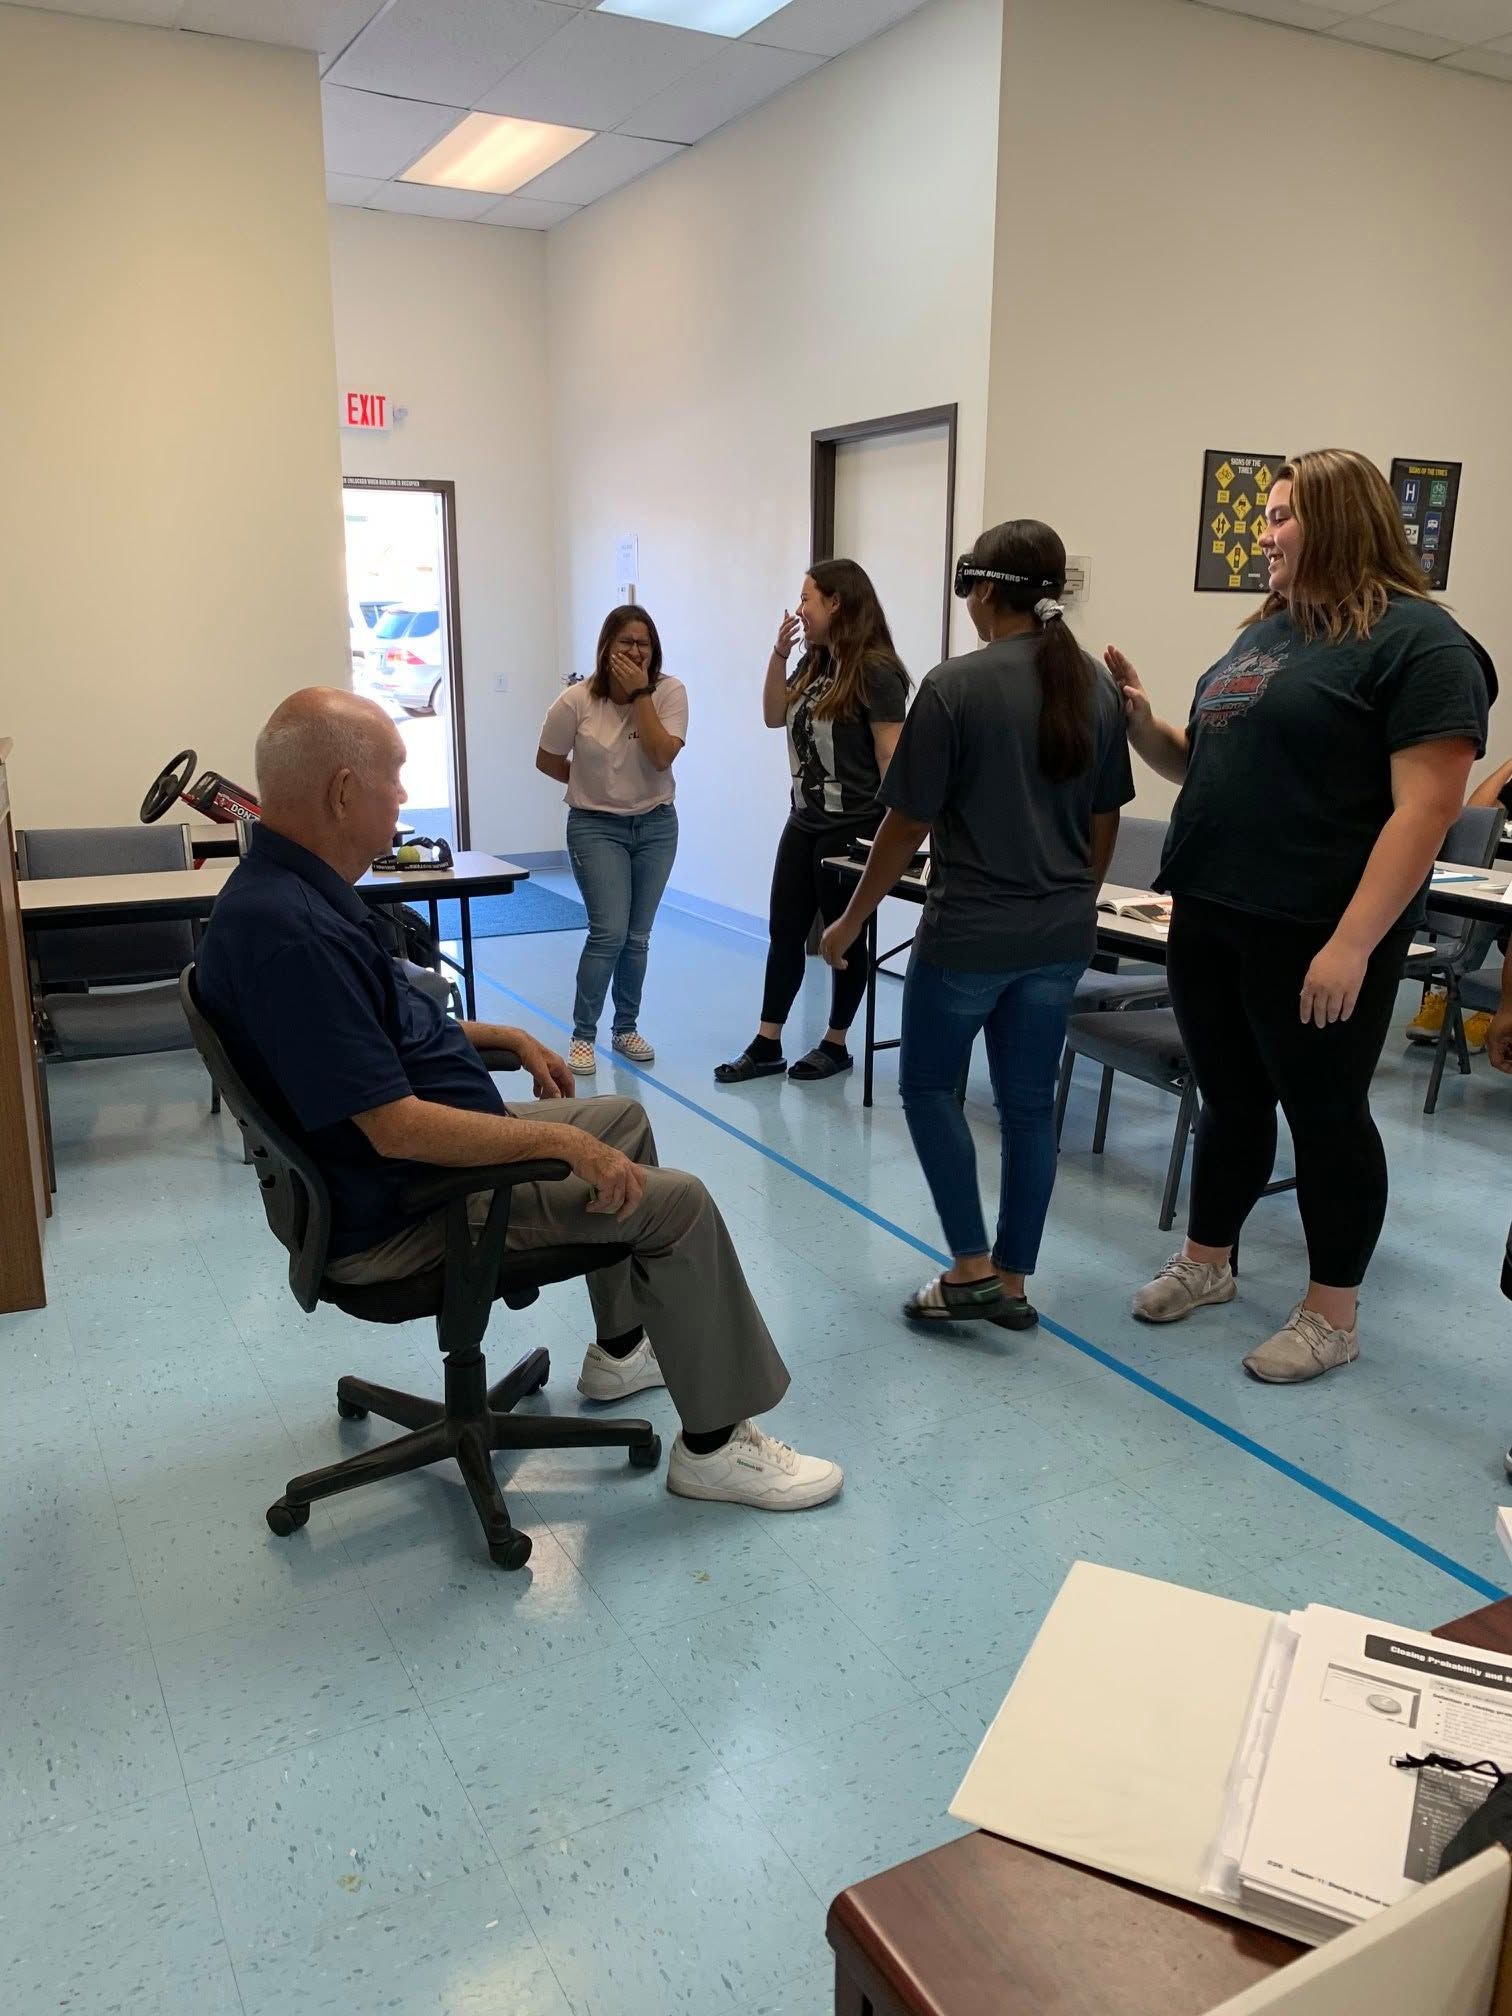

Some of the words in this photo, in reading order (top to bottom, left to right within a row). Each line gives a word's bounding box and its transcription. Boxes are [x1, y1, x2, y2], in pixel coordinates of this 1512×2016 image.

[347, 392, 386, 427] EXIT
[1252, 459, 1261, 467] THE
[1405, 483, 1416, 501] H
[963, 568, 986, 577] DRUNK
[1389, 1645, 1426, 1662] Closing
[1427, 1656, 1483, 1677] Probability
[1484, 1672, 1503, 1681] and
